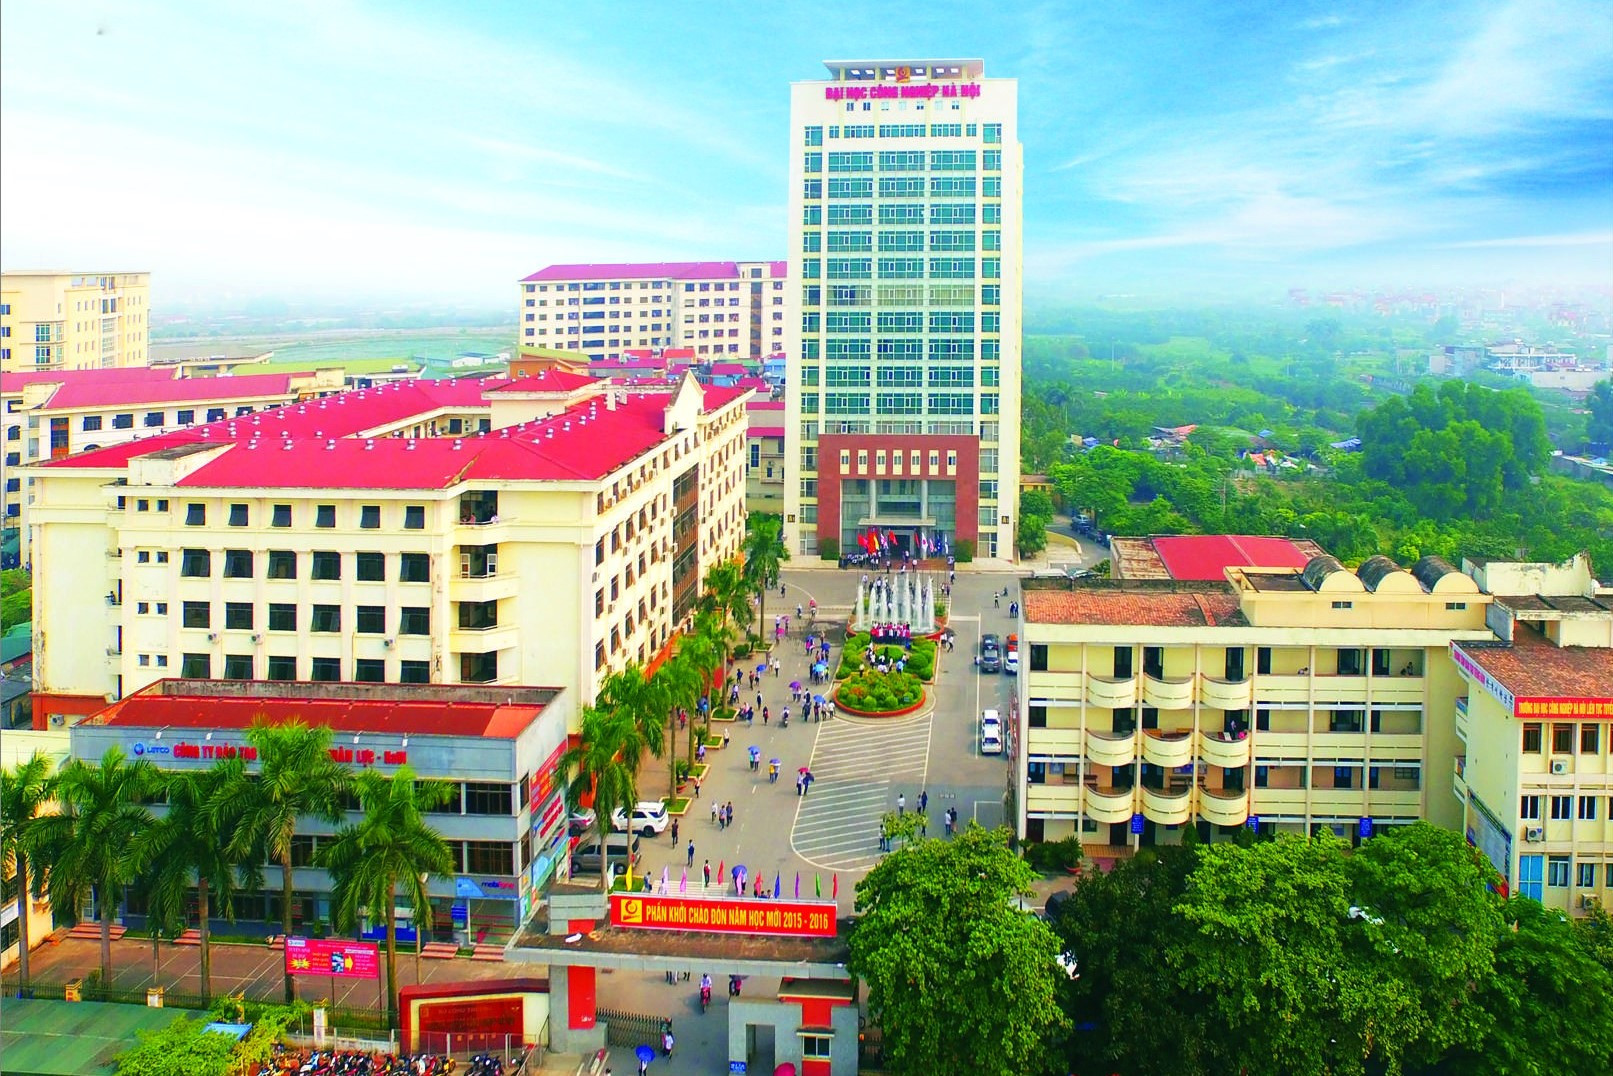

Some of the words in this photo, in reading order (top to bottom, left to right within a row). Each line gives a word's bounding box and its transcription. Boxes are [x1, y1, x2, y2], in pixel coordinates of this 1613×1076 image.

[825, 87, 844, 101] ĐẠI
[846, 87, 867, 101] HỌC
[870, 84, 898, 98] CÔNG
[942, 82, 957, 97] HÀ
[961, 82, 980, 99] NỘI
[646, 900, 668, 922] PHẤN
[669, 902, 687, 923] KHỞI
[688, 904, 709, 925] CHÀO
[710, 905, 727, 925] ĐÓN
[729, 906, 747, 926] NĂM
[748, 909, 764, 930] HỌC
[766, 907, 782, 927] MỚI
[783, 911, 802, 928] 2015
[809, 912, 829, 930] 2016
